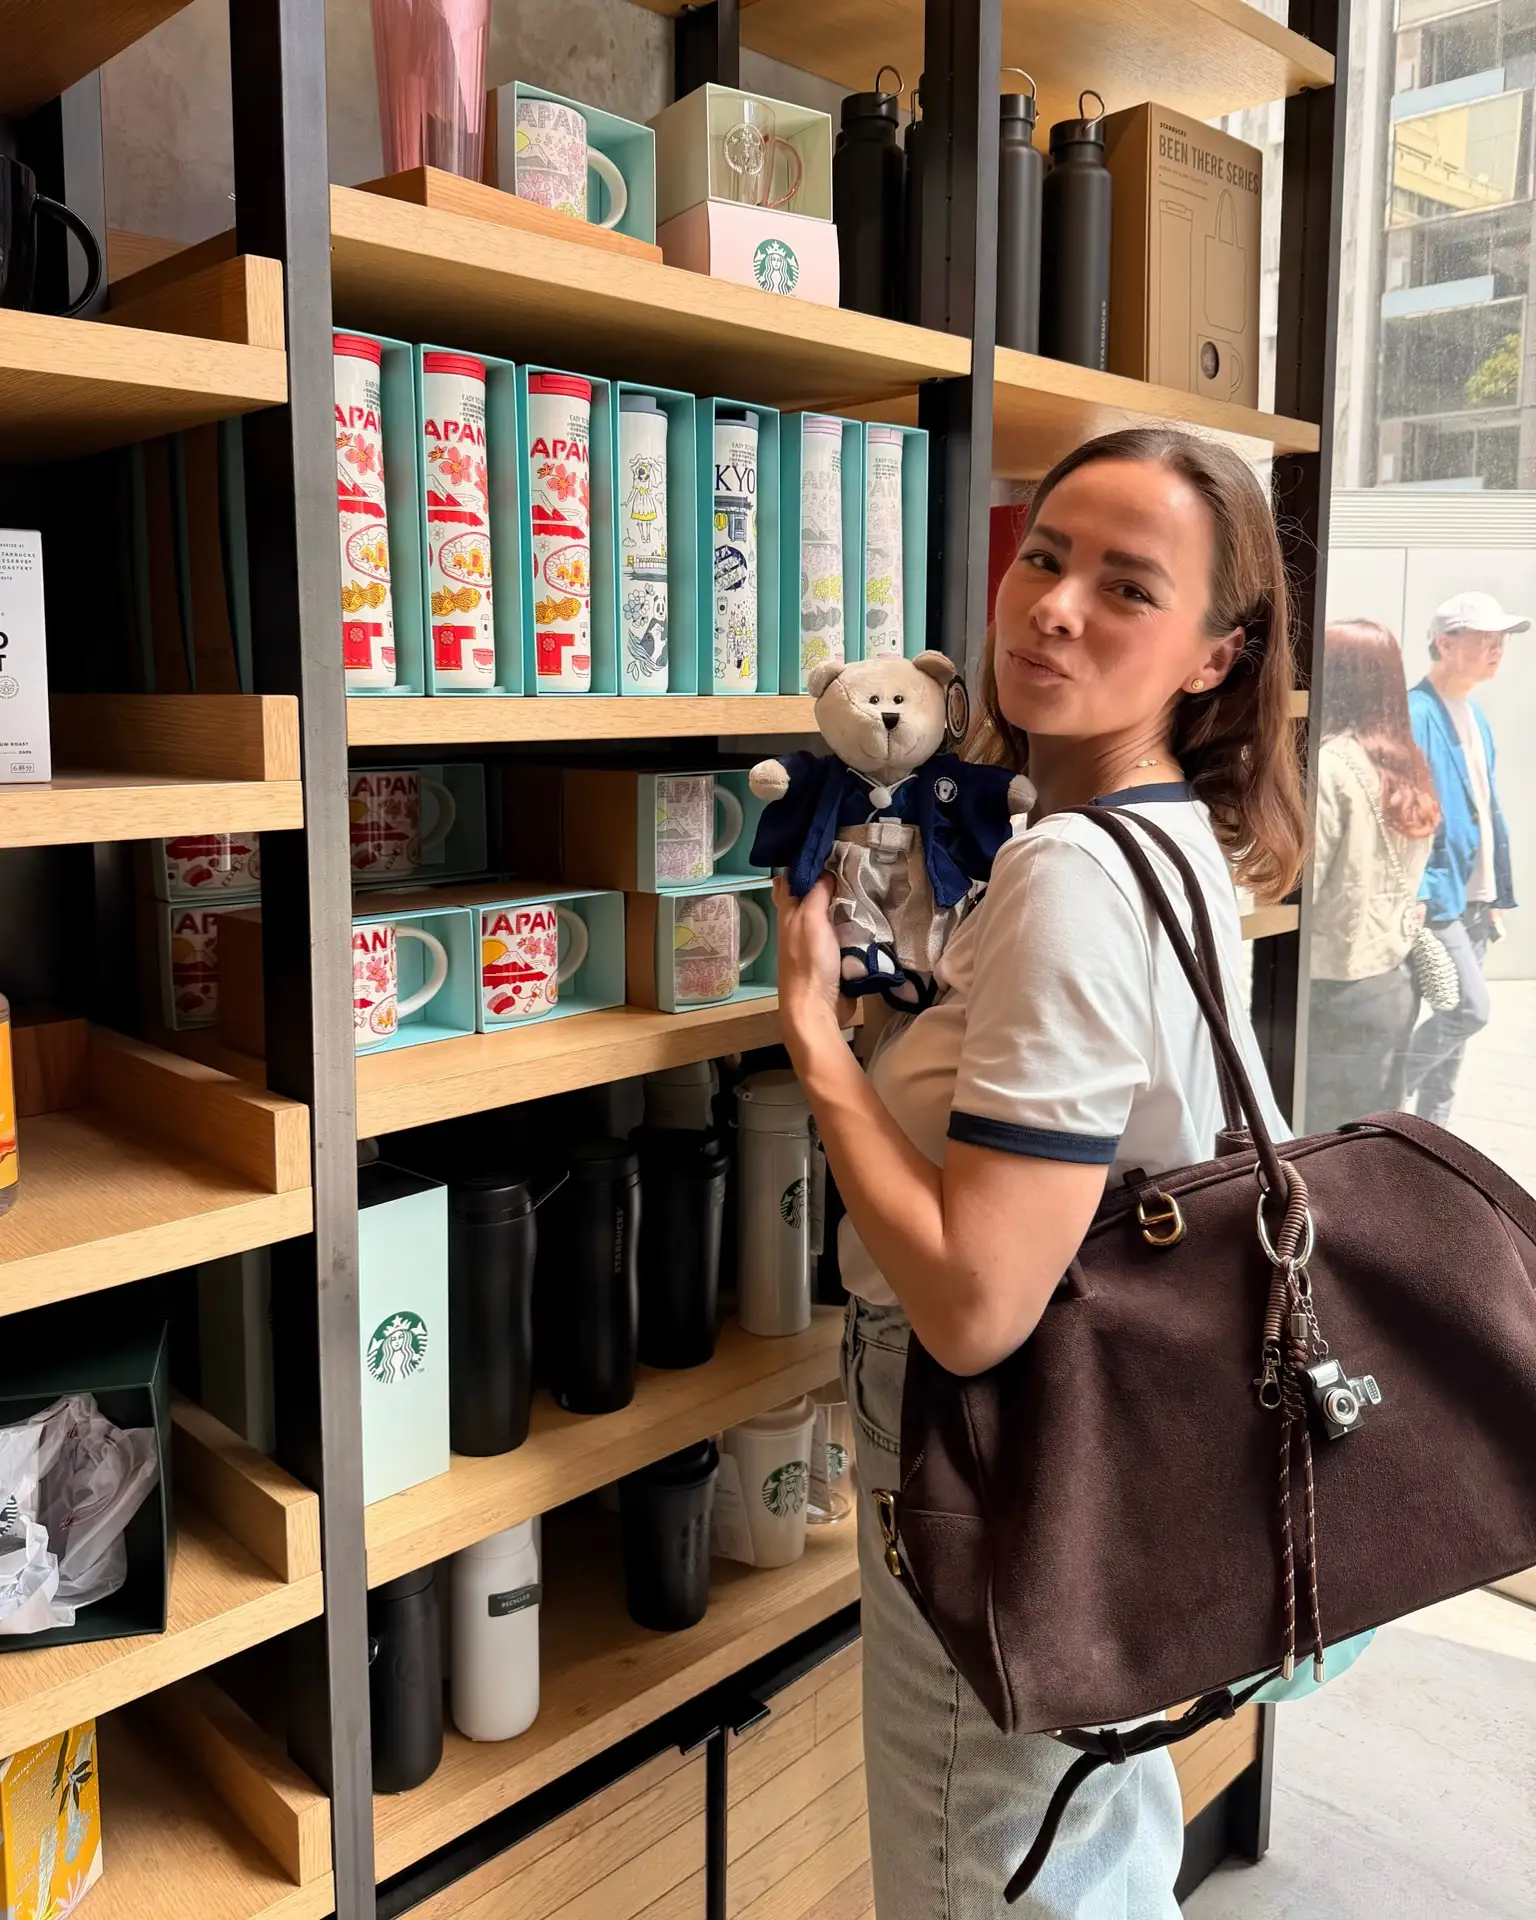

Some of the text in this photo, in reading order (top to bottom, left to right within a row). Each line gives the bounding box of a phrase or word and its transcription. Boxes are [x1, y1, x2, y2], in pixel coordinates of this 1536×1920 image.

[1160, 135, 1188, 166] BEEN
[1191, 146, 1224, 179] THERE
[1226, 161, 1260, 195] SERIES
[334, 403, 381, 433] APA
[715, 464, 756, 494] KYO
